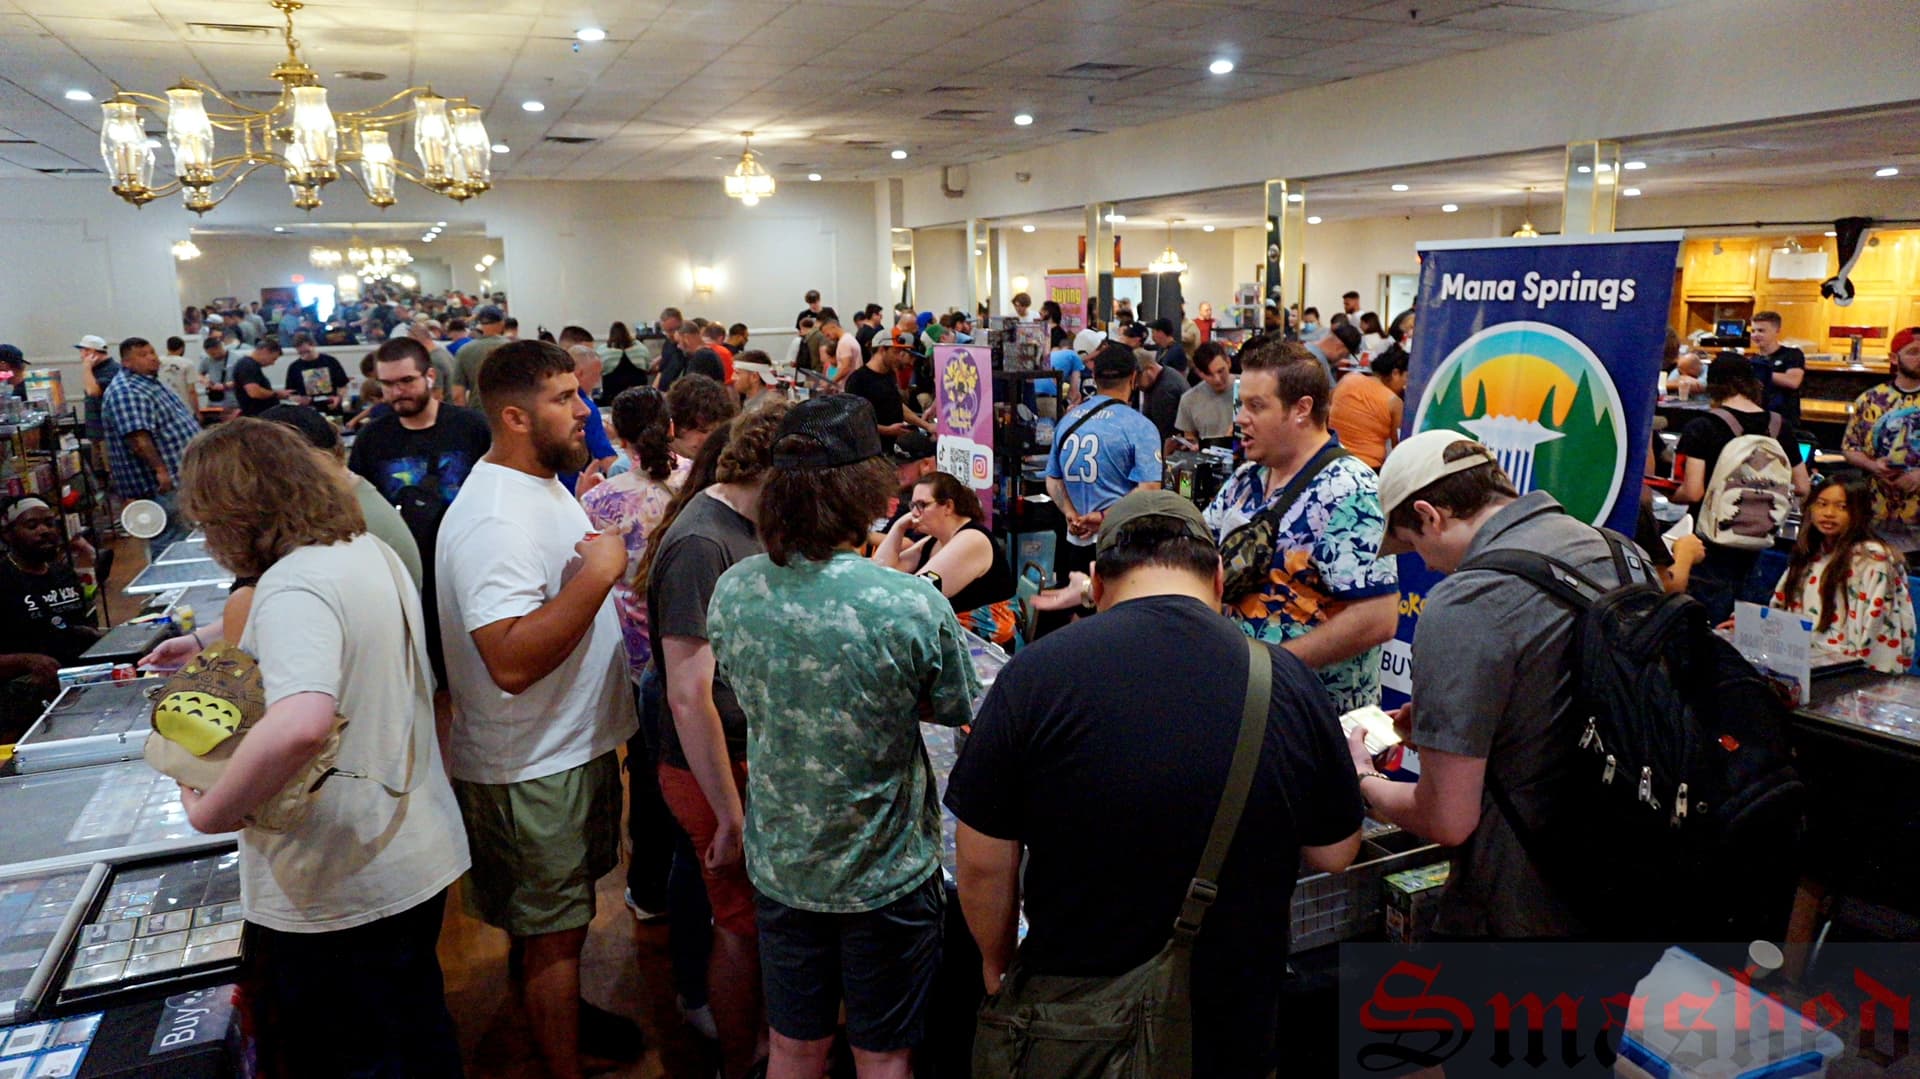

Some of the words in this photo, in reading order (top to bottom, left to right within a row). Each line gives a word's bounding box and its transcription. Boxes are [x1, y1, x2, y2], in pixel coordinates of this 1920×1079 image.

[1440, 273, 1515, 301] Mana
[1522, 270, 1636, 310] Springs
[1062, 433, 1099, 483] 23
